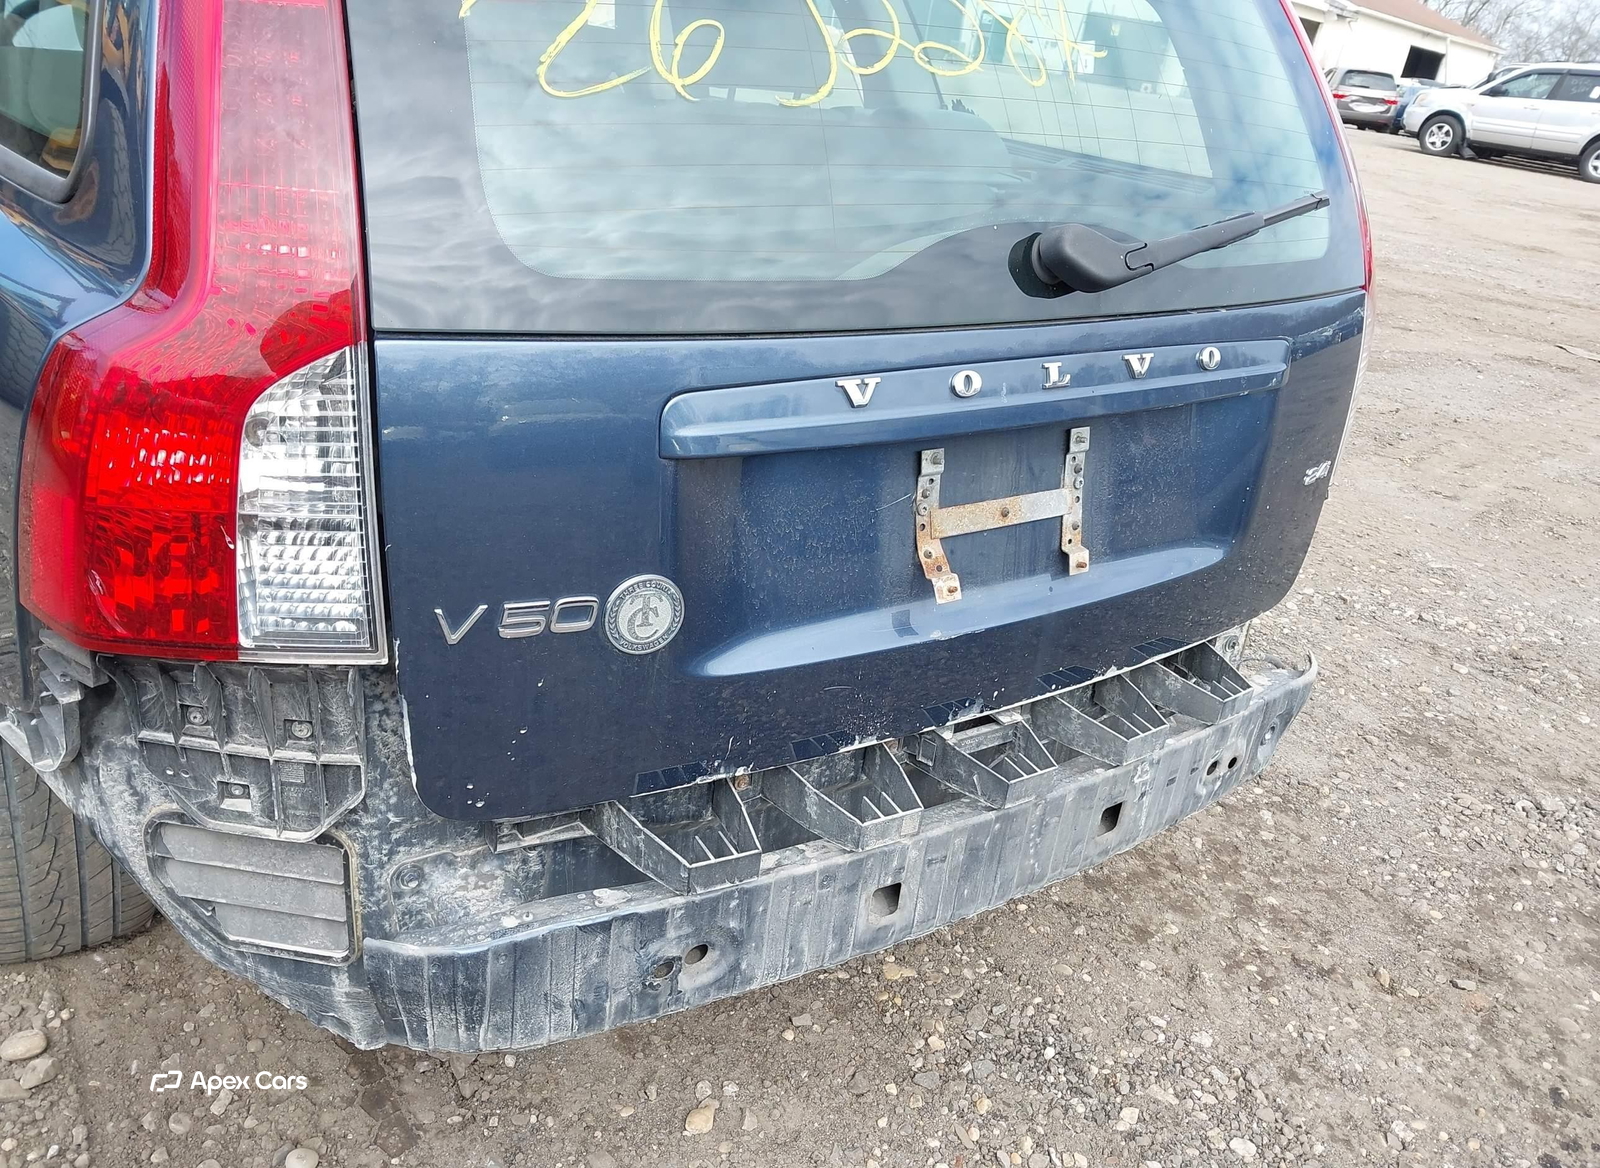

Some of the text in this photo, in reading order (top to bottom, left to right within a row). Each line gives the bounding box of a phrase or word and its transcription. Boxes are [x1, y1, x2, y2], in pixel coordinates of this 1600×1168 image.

[836, 346, 1222, 408] VOLVO
[619, 583, 645, 601] THREE
[620, 635, 669, 651] VOLKSWAGEN
